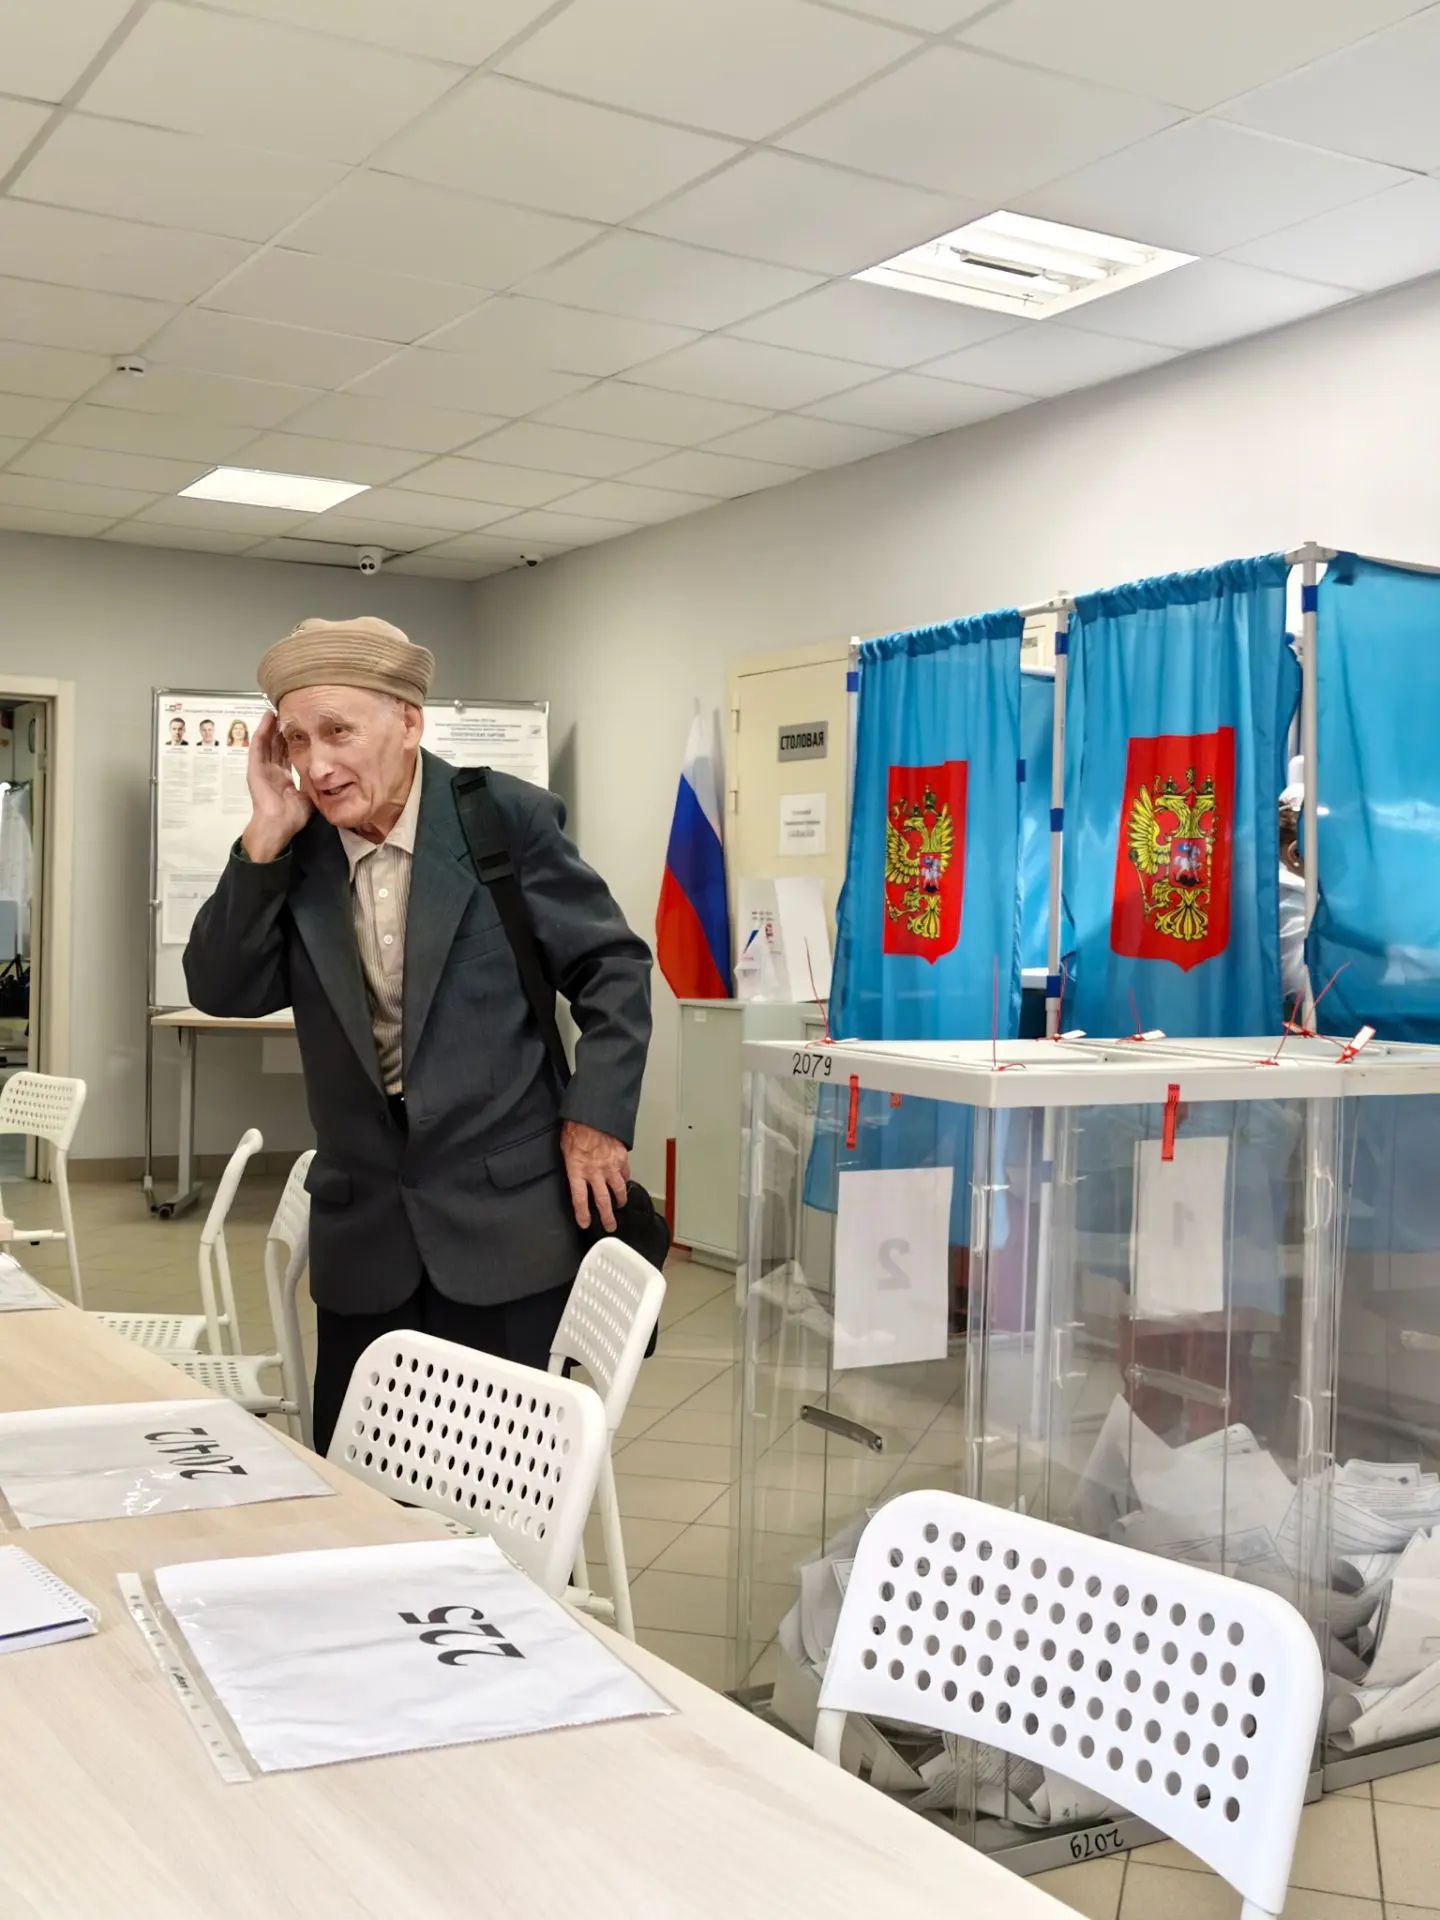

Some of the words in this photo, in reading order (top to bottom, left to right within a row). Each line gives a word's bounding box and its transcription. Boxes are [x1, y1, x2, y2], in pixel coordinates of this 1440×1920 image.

[780, 731, 824, 751] СТОЛОВАЯ
[792, 1052, 832, 1078] 2079
[398, 1605, 526, 1666] 225
[1070, 1828, 1124, 1858] 2079
